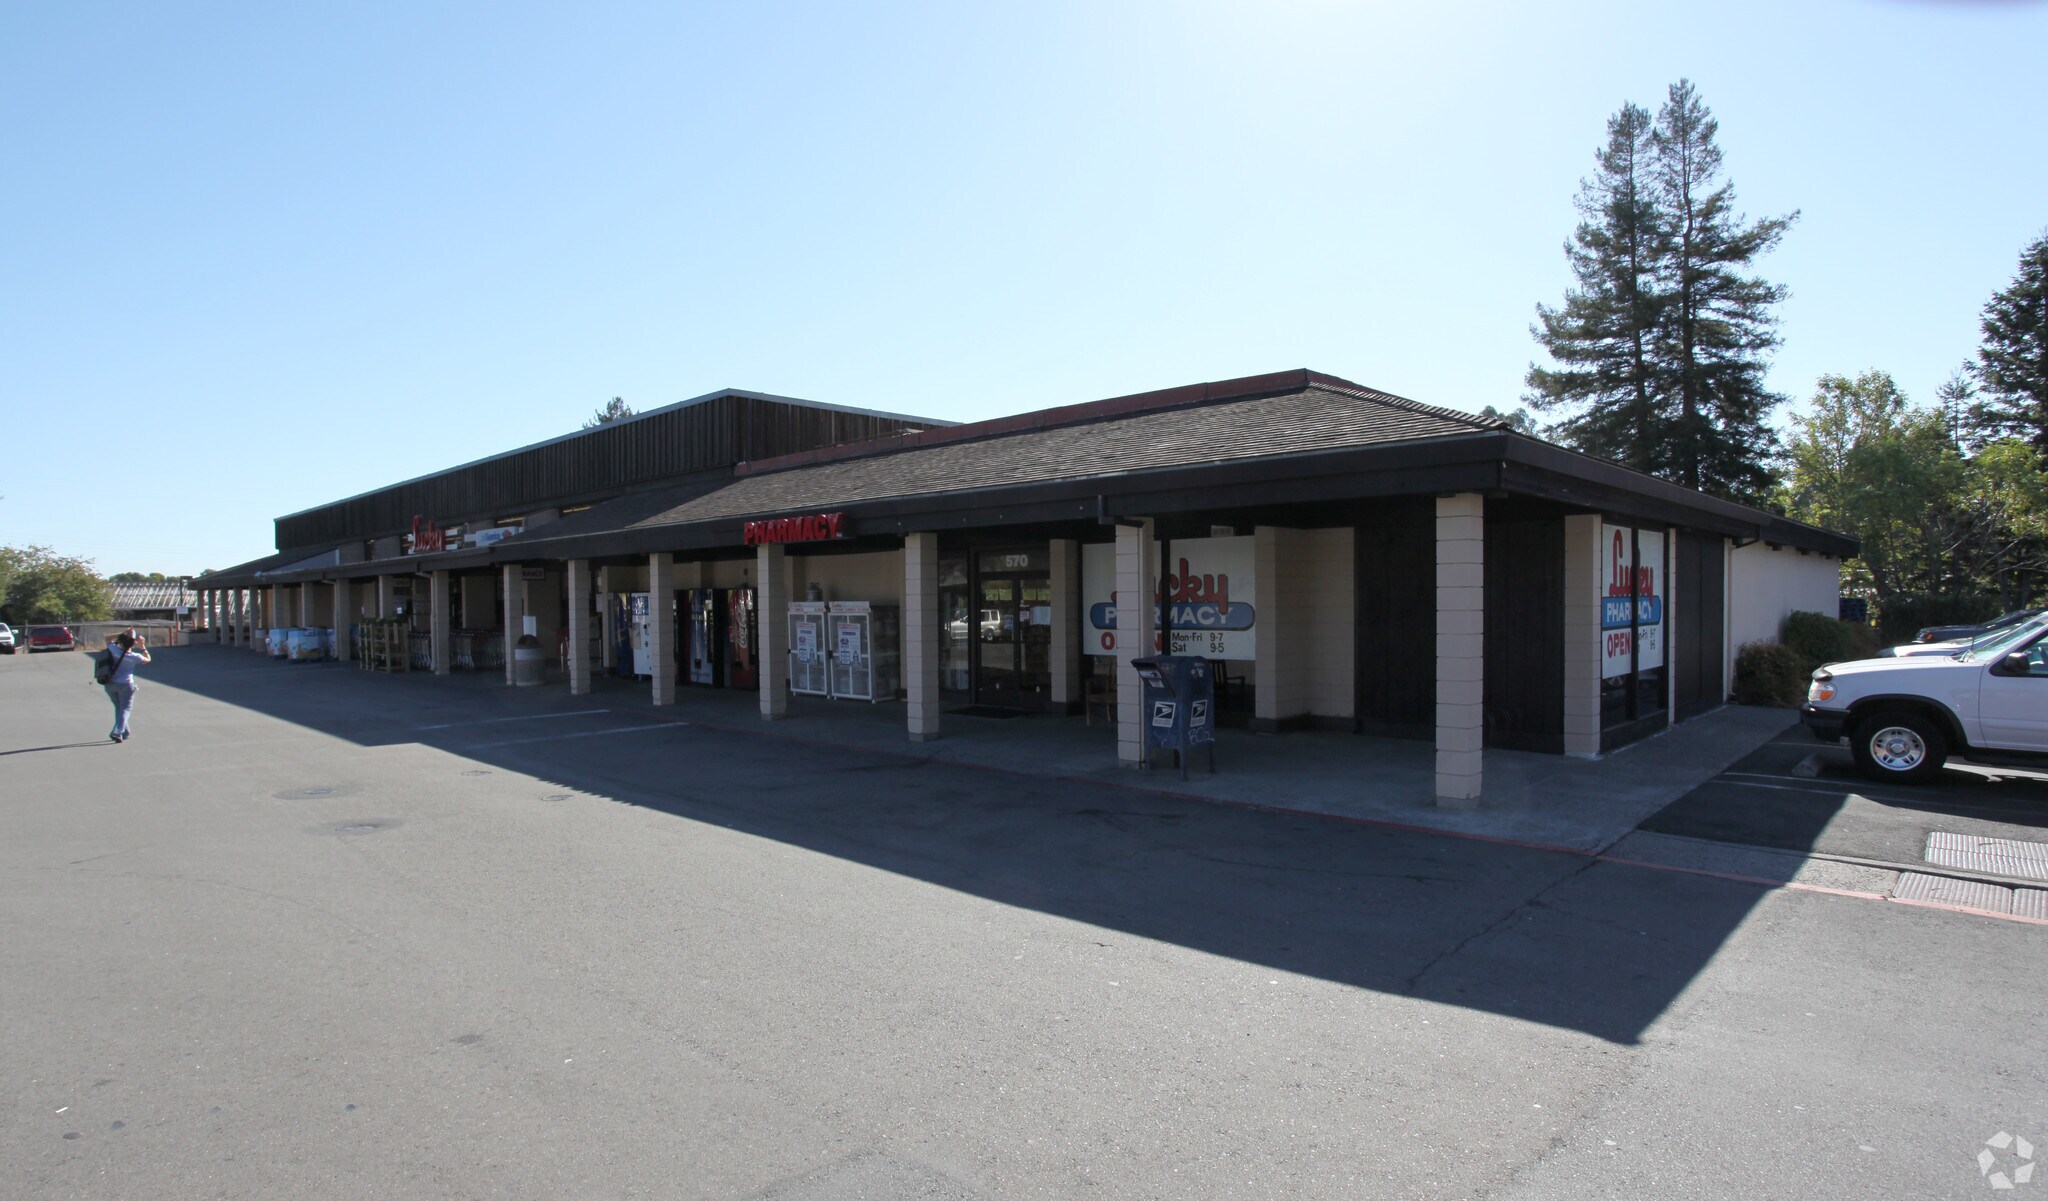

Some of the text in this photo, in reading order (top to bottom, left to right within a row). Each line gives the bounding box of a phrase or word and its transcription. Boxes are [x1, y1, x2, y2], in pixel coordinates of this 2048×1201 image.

[744, 513, 844, 544] PHARMACY
[1006, 554, 1028, 567] 570
[1609, 529, 1653, 608] Luky
[1606, 601, 1652, 623] PHARACY
[1172, 642, 1224, 653] Sat 9-5
[1210, 632, 1223, 642] 9-7
[1607, 631, 1631, 658] OPEN
